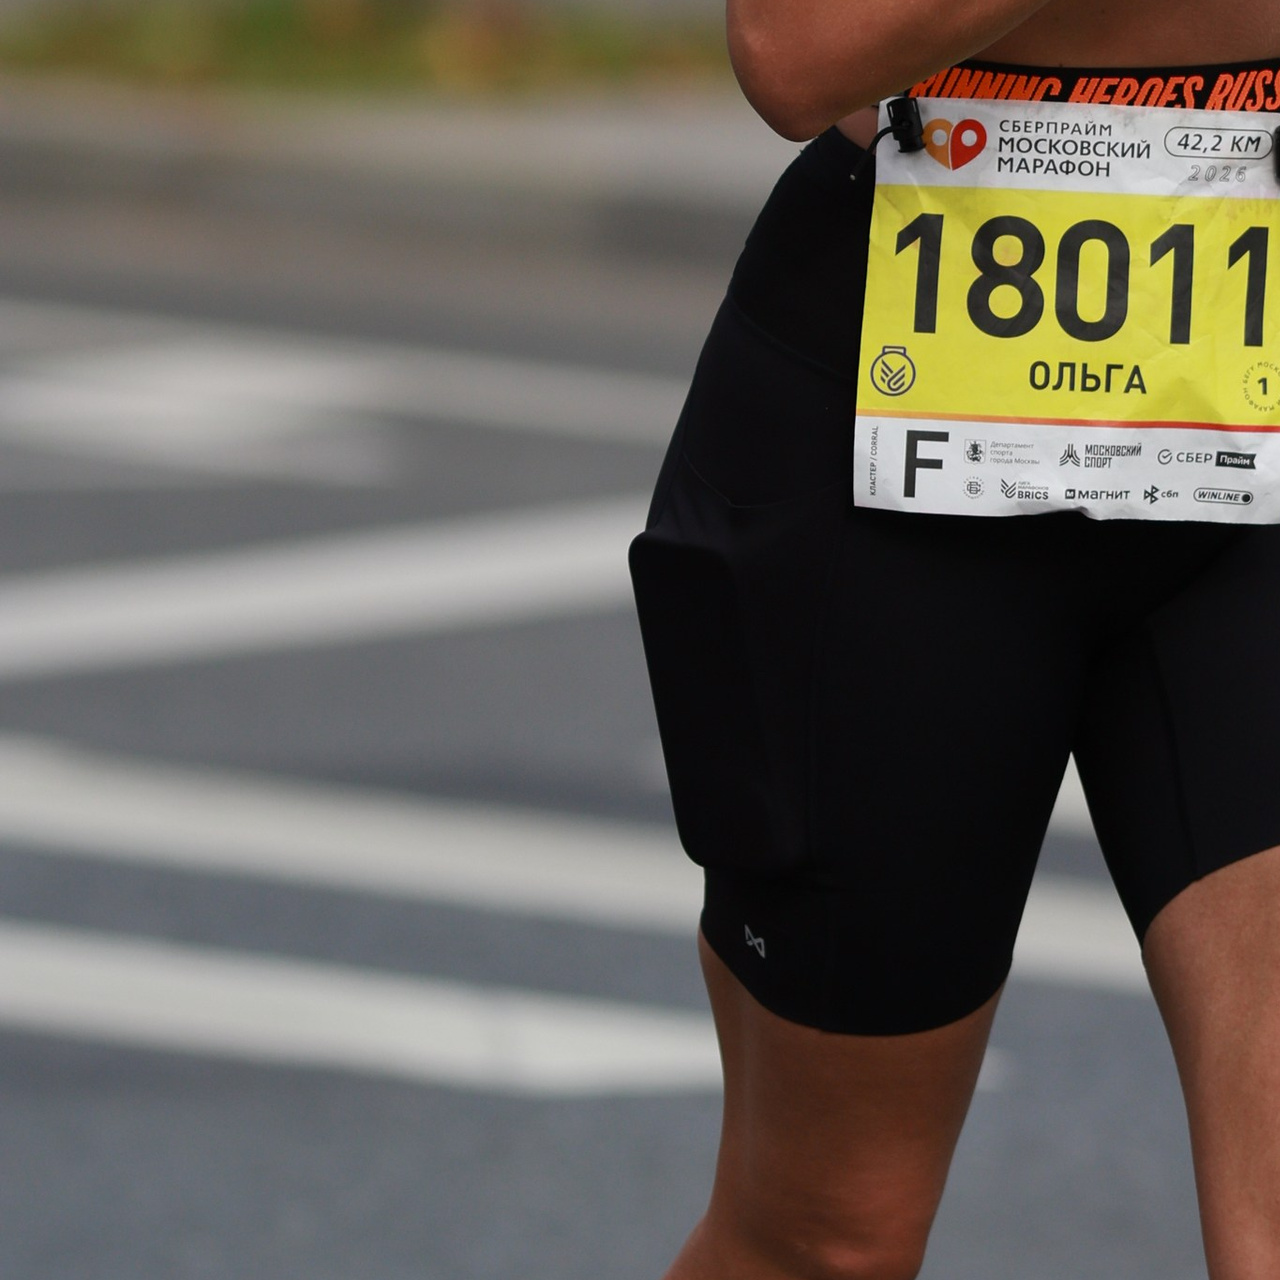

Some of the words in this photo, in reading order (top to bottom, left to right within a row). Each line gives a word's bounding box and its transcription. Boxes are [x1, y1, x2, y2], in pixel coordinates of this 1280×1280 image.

[1067, 75, 1204, 110] HEROES
[999, 119, 1112, 137] СБЕРПРАЙМ
[998, 137, 1151, 159] МОСКОВСКИЙ
[1177, 133, 1222, 152] 42,2
[1230, 135, 1262, 153] КМ
[997, 156, 1110, 178] МАРАФОН
[1187, 164, 1248, 183] 2026
[894, 212, 1270, 348] 18011
[1028, 360, 1148, 395] ОЛЬГА
[1257, 377, 1268, 396] 1
[870, 425, 879, 456] CORRAL
[1084, 443, 1142, 457] МОСКОВСКИЙ
[903, 429, 950, 498] F
[1084, 456, 1113, 468] СПОРТ
[1176, 452, 1213, 464] СБЕР
[1219, 454, 1251, 466] Прайм
[869, 462, 877, 496] КЛАСТЕР
[1017, 490, 1049, 500] BRICS
[1078, 489, 1131, 500] магнит
[1160, 490, 1179, 499] сбп
[1197, 489, 1240, 502] WINLINE
